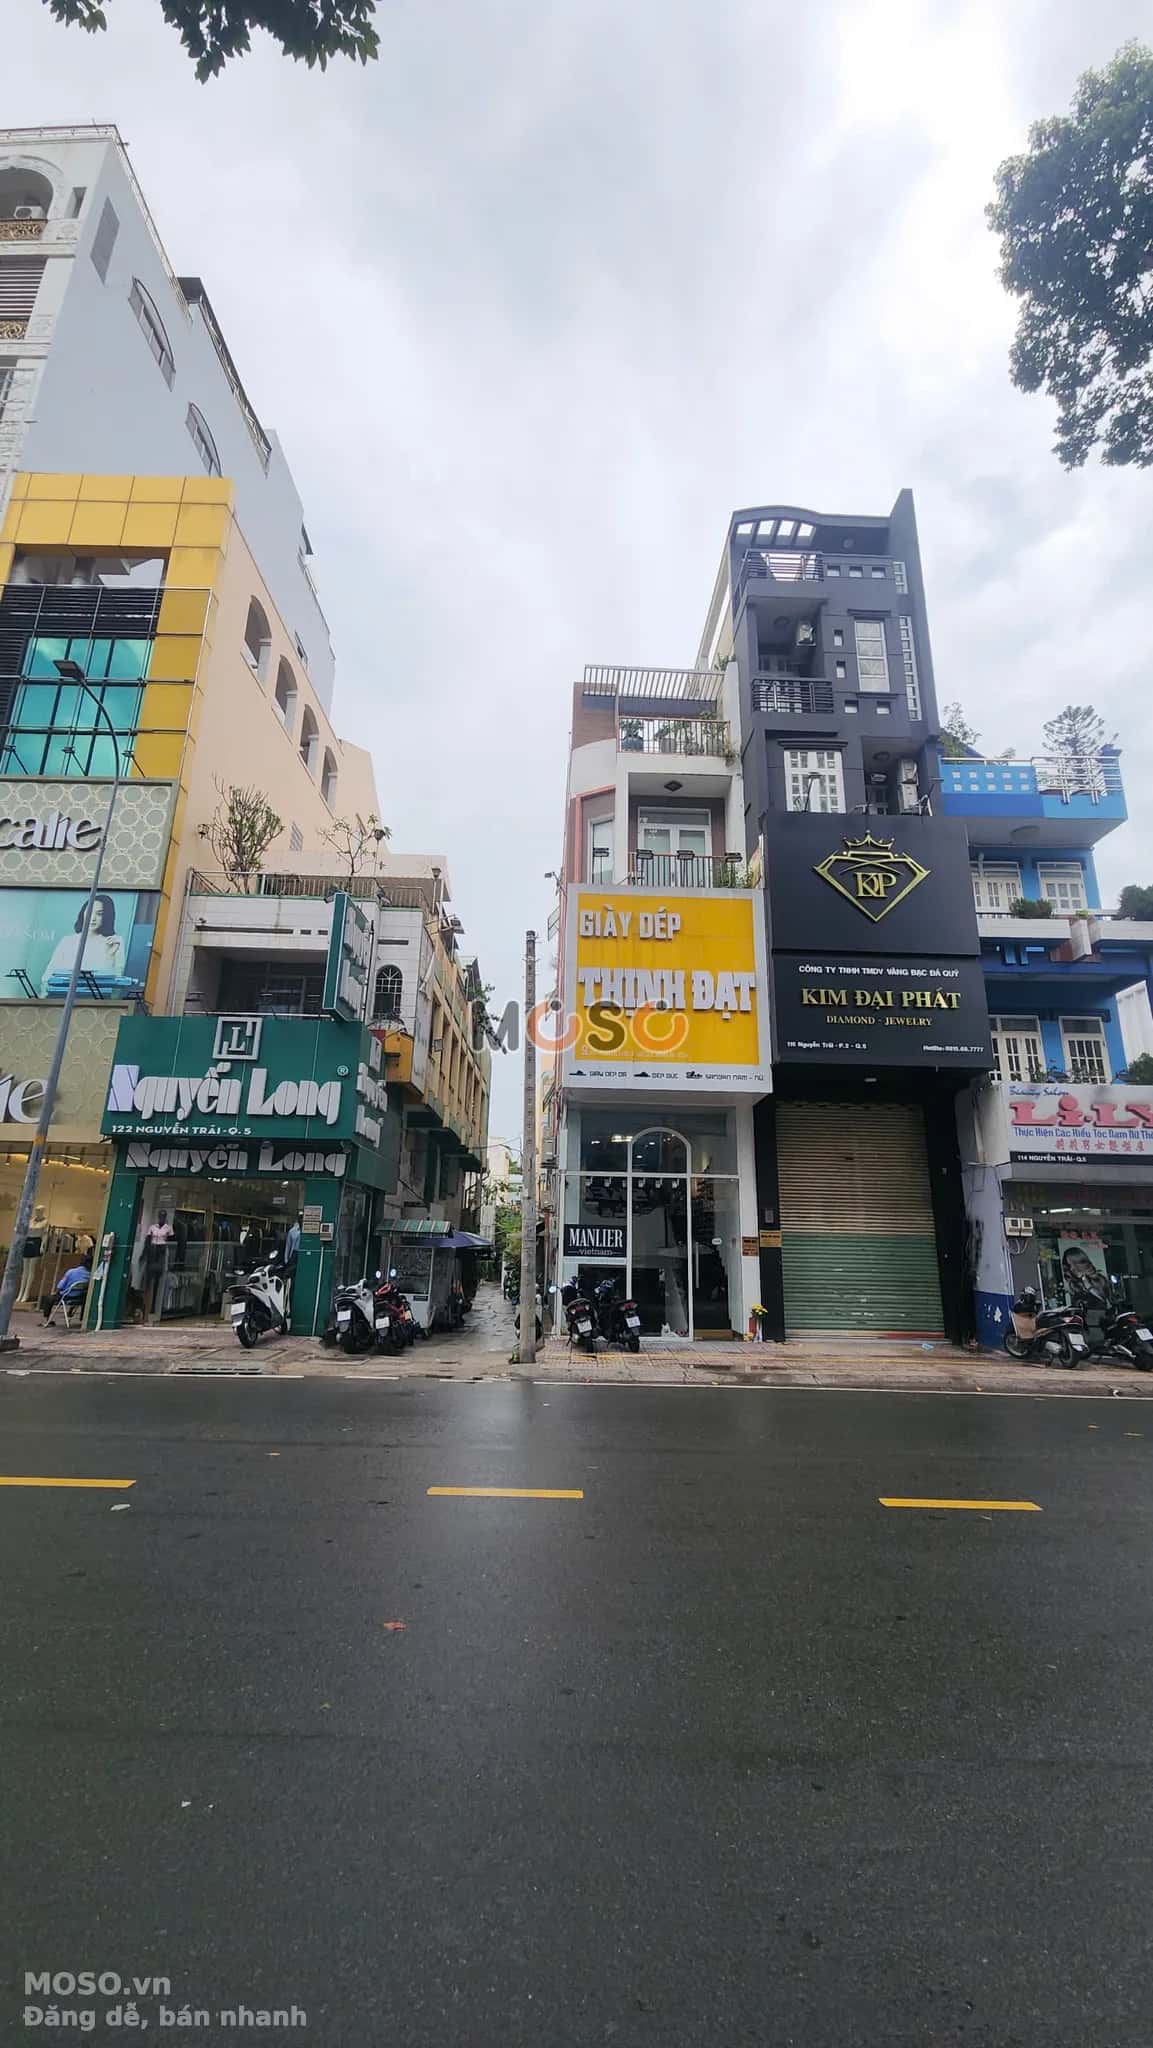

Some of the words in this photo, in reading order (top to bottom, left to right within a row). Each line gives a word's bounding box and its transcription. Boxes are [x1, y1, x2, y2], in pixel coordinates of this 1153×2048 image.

[580, 904, 632, 938] GIÀY
[640, 906, 681, 940] DÉP
[799, 964, 822, 974] CÔNG
[825, 966, 836, 974] TY
[886, 967, 908, 977] VÀNG
[691, 971, 757, 1020] ĐẠT
[801, 987, 848, 1006] KIM
[854, 989, 895, 1010] ĐẠI
[901, 986, 961, 1009] PHÁT
[827, 1015, 876, 1025] DIAMOND
[884, 1016, 933, 1026] JEWELRY
[246, 1067, 342, 1126] Long
[112, 1125, 133, 1133] 122
[135, 1122, 189, 1135] NGUYỄN
[258, 1141, 347, 1177] Long
[569, 1228, 623, 1248] MANLIER
